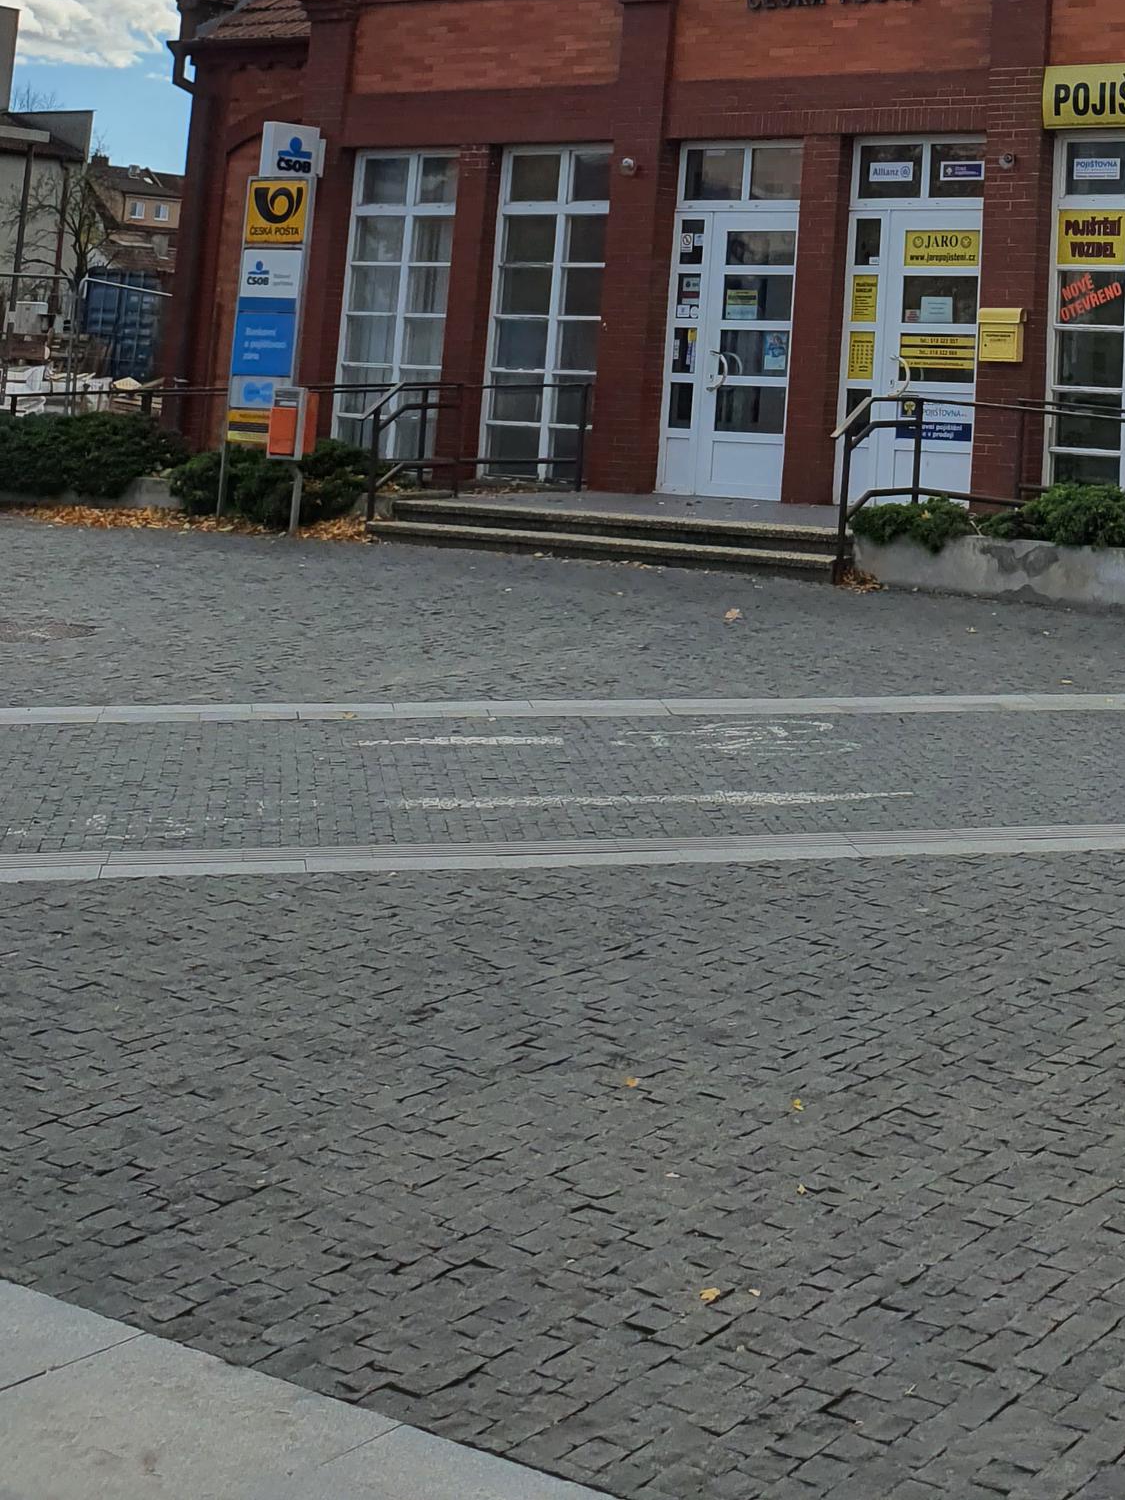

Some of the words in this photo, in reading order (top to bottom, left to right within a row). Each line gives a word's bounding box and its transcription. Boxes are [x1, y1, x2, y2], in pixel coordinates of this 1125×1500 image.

[276, 156, 312, 174] ČSOB
[872, 166, 899, 176] Allianz
[250, 226, 273, 236] ČESKÁ
[274, 224, 300, 236] POŠTA
[1064, 216, 1123, 237] POJIŠTĚNÍ
[924, 234, 959, 249] JARO
[1070, 241, 1116, 259] VOZIDEL
[246, 275, 270, 286] ČSOB
[1061, 272, 1095, 302] NOVĚ
[1060, 280, 1123, 322] OTEVŘENO
